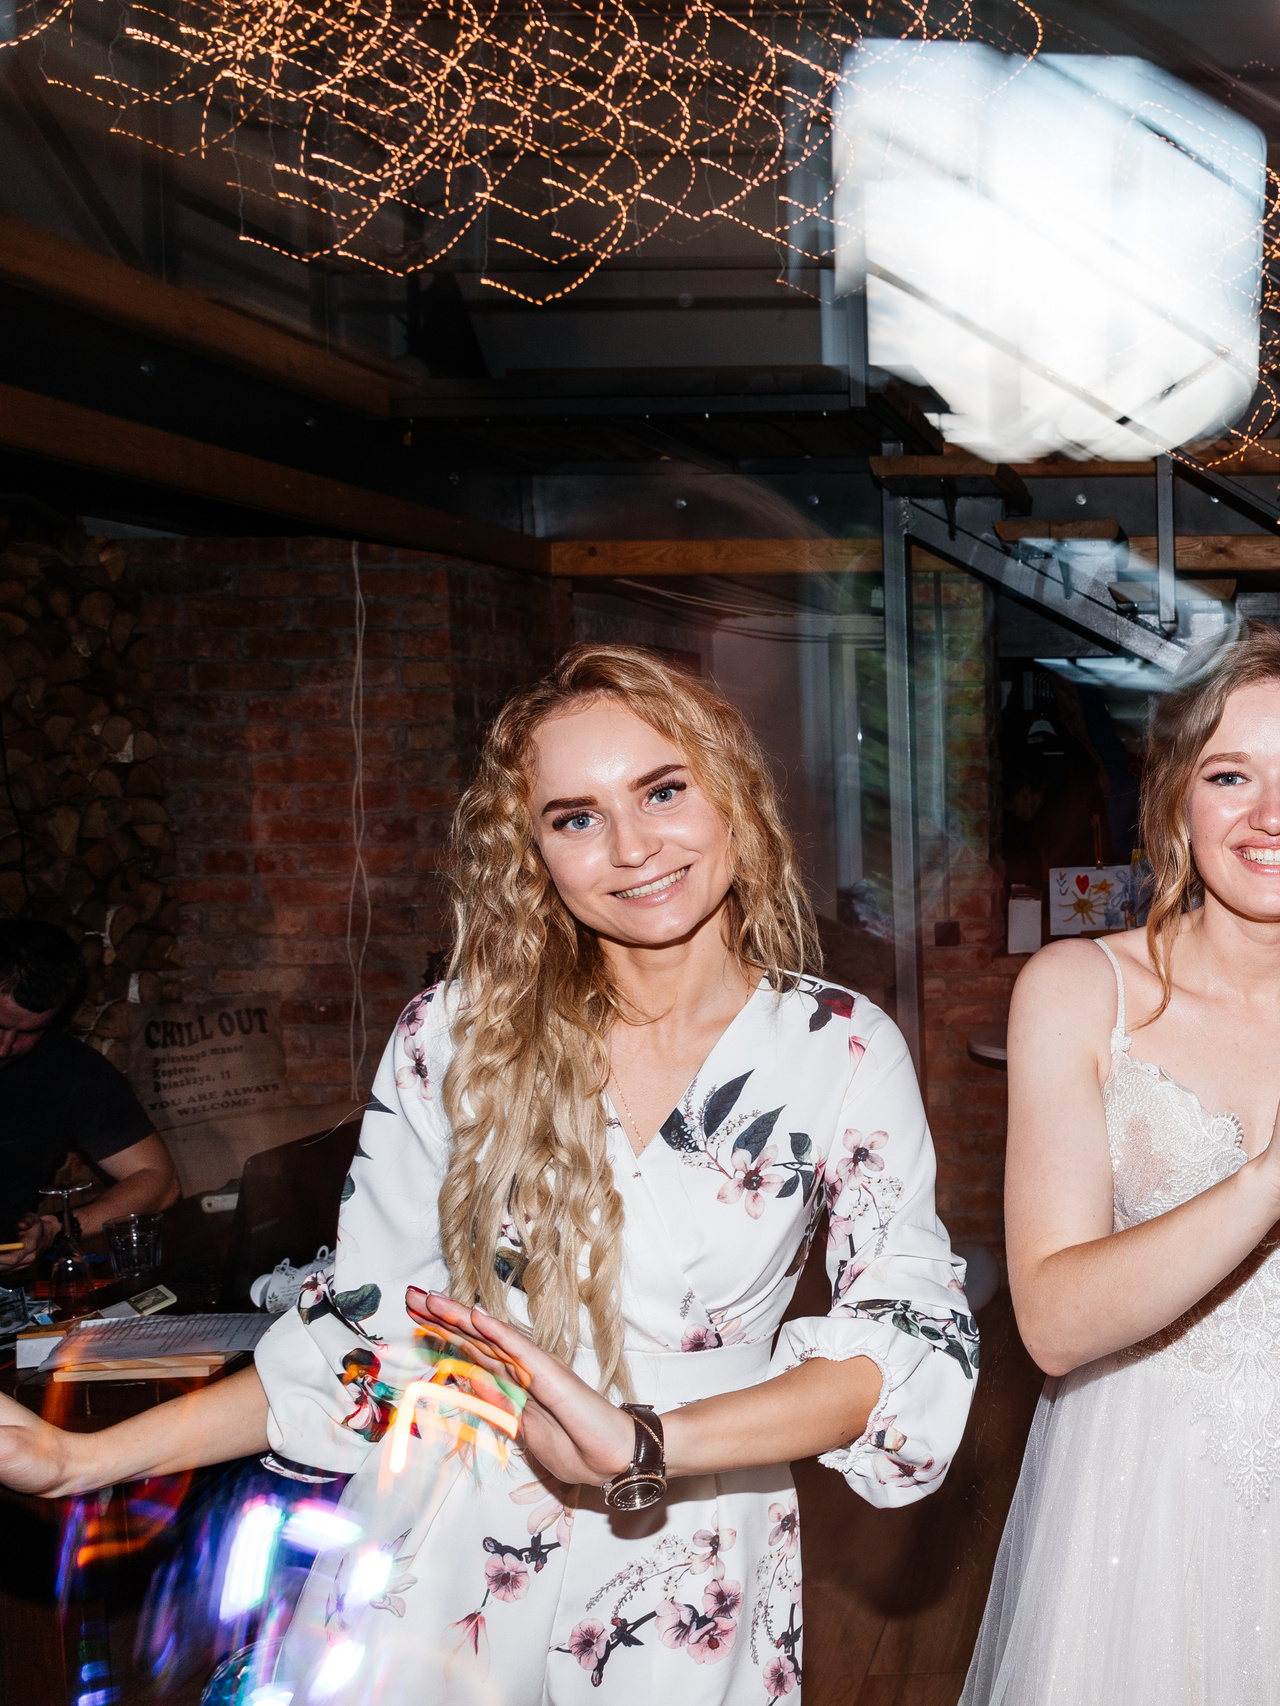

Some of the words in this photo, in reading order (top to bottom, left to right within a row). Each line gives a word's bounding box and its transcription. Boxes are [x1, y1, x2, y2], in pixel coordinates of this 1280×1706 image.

[144, 1015, 213, 1049] CHILL
[218, 1008, 268, 1036] OUT
[149, 1098, 181, 1110] YOU
[187, 1092, 217, 1104] ARE
[223, 1083, 280, 1097] ALWAYS
[177, 1098, 256, 1116] WELCOME!
